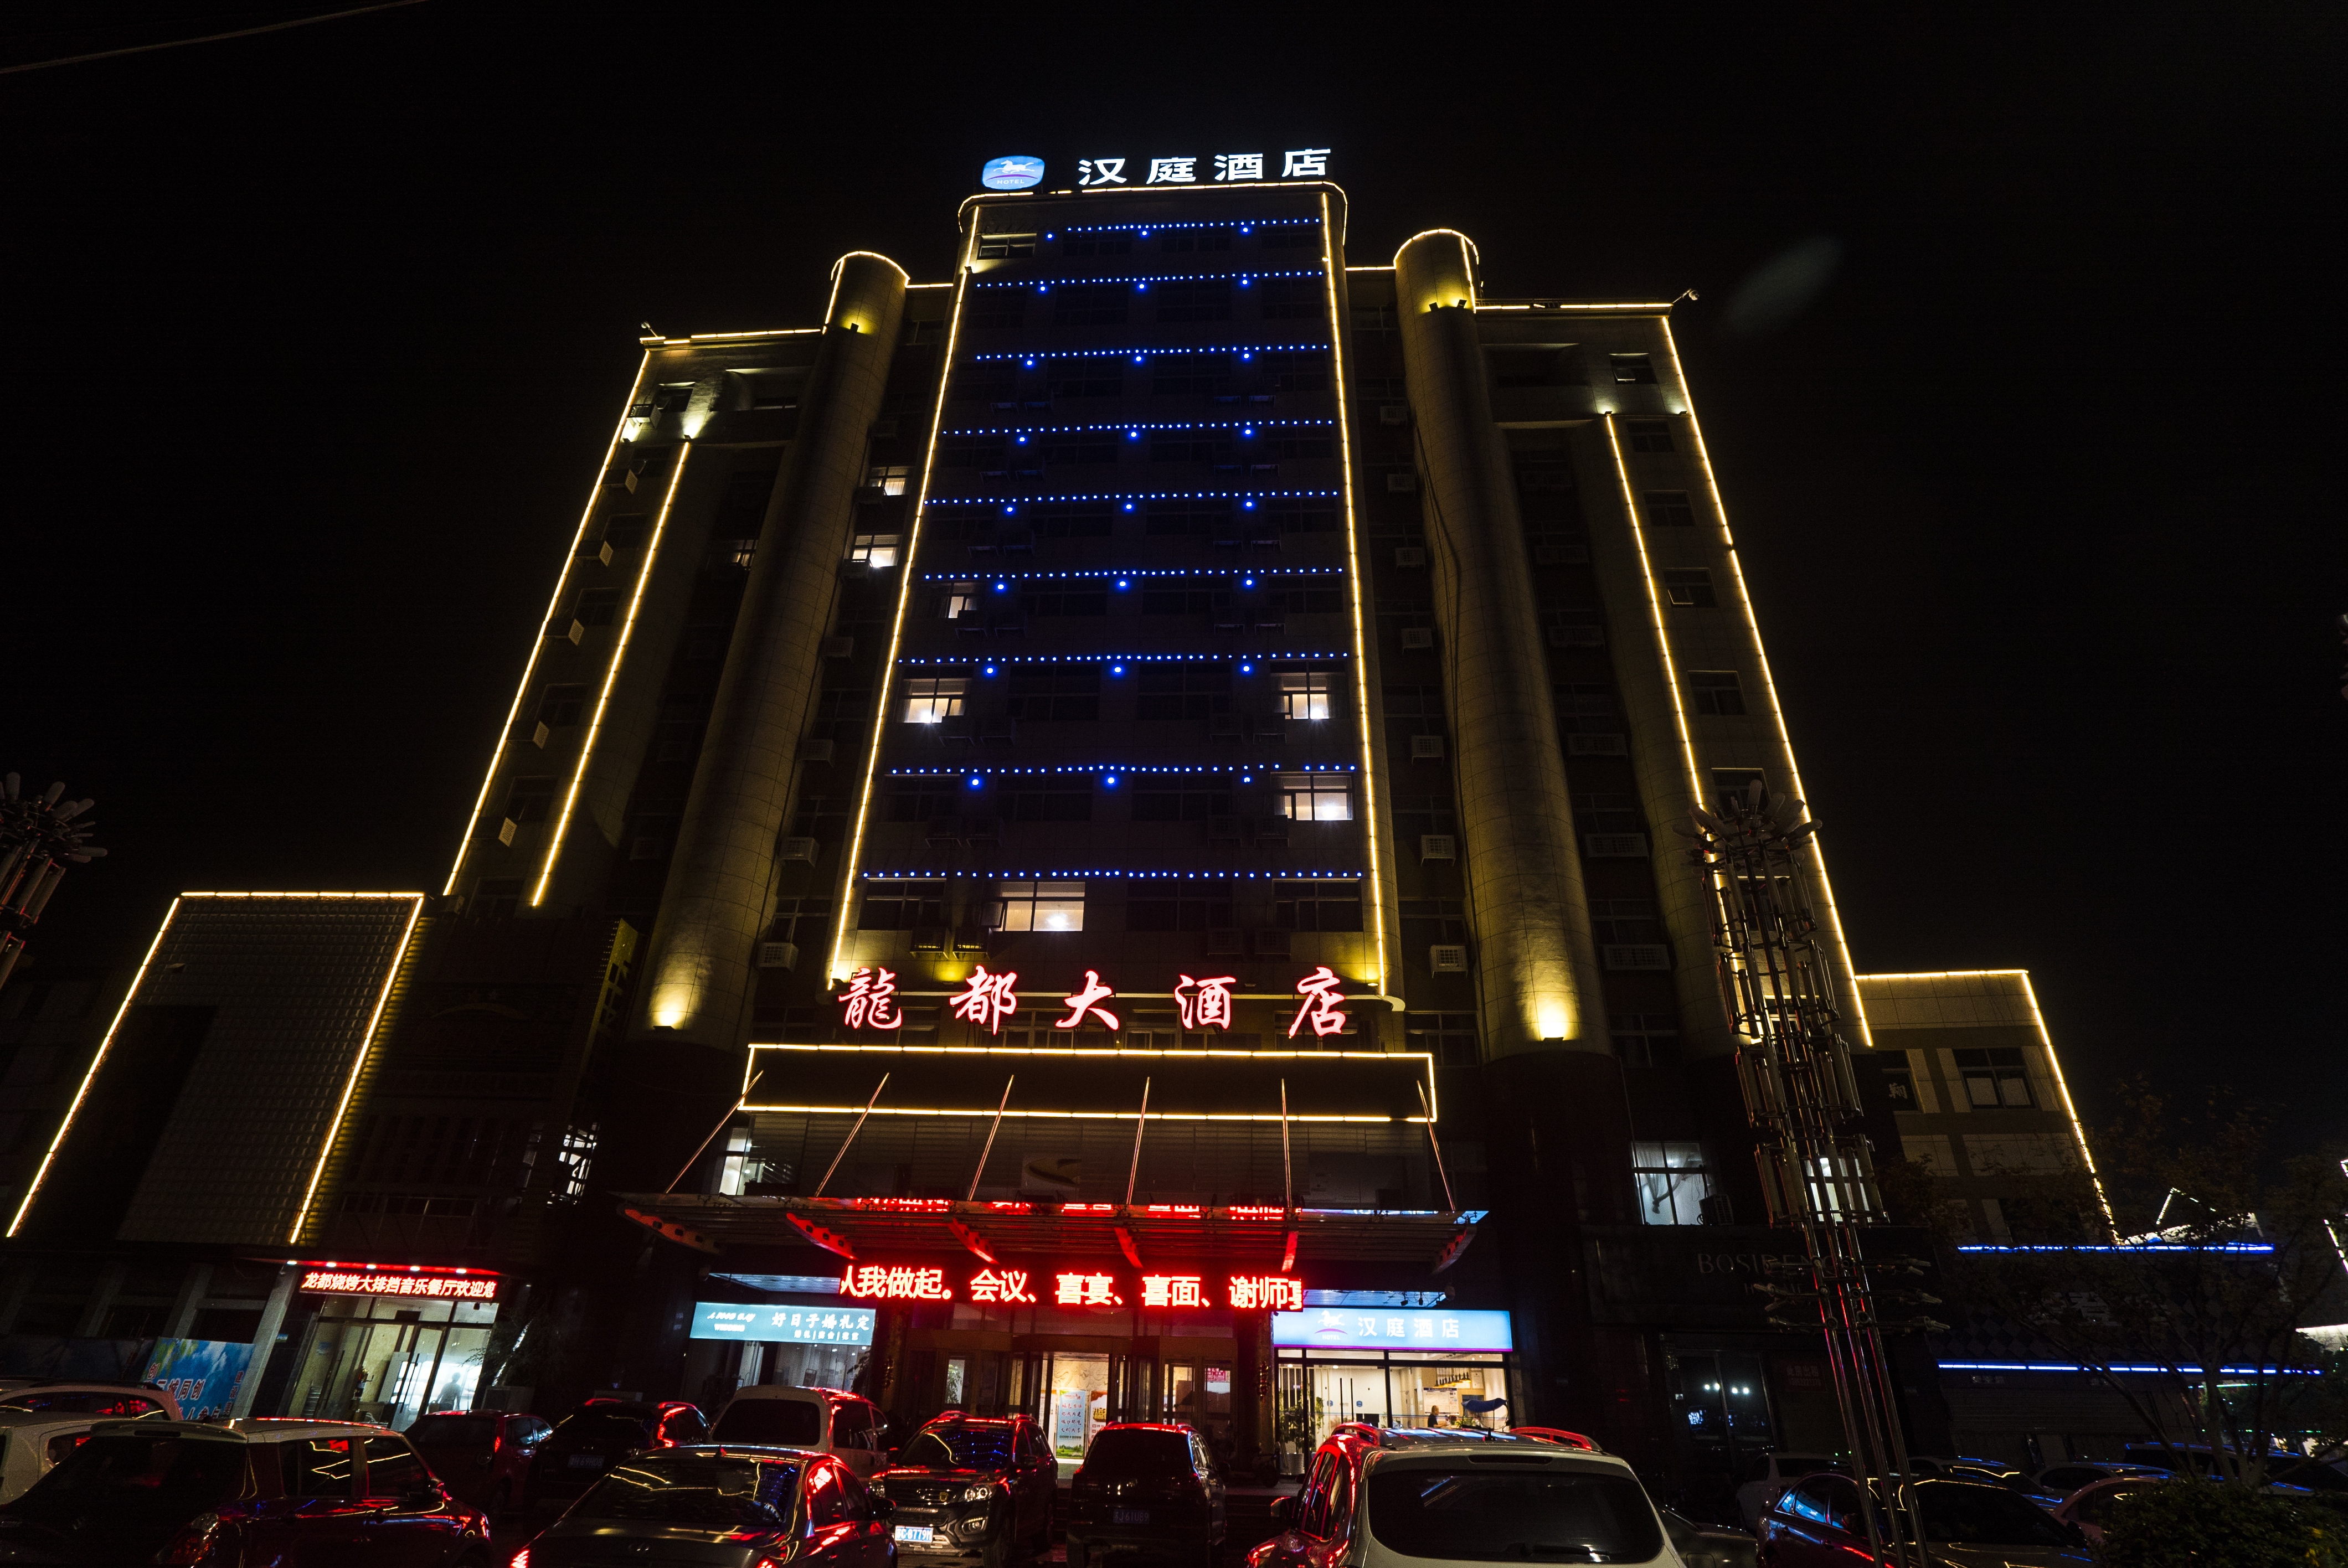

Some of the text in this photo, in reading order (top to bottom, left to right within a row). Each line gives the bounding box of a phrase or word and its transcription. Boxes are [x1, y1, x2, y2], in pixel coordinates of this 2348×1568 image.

[1079, 148, 1331, 185] 汉庭酒店
[838, 965, 1346, 1038] 龍都大酒店
[771, 1312, 869, 1330] 好日子婚礼定
[1358, 1317, 1460, 1338] 汉庭酒店
